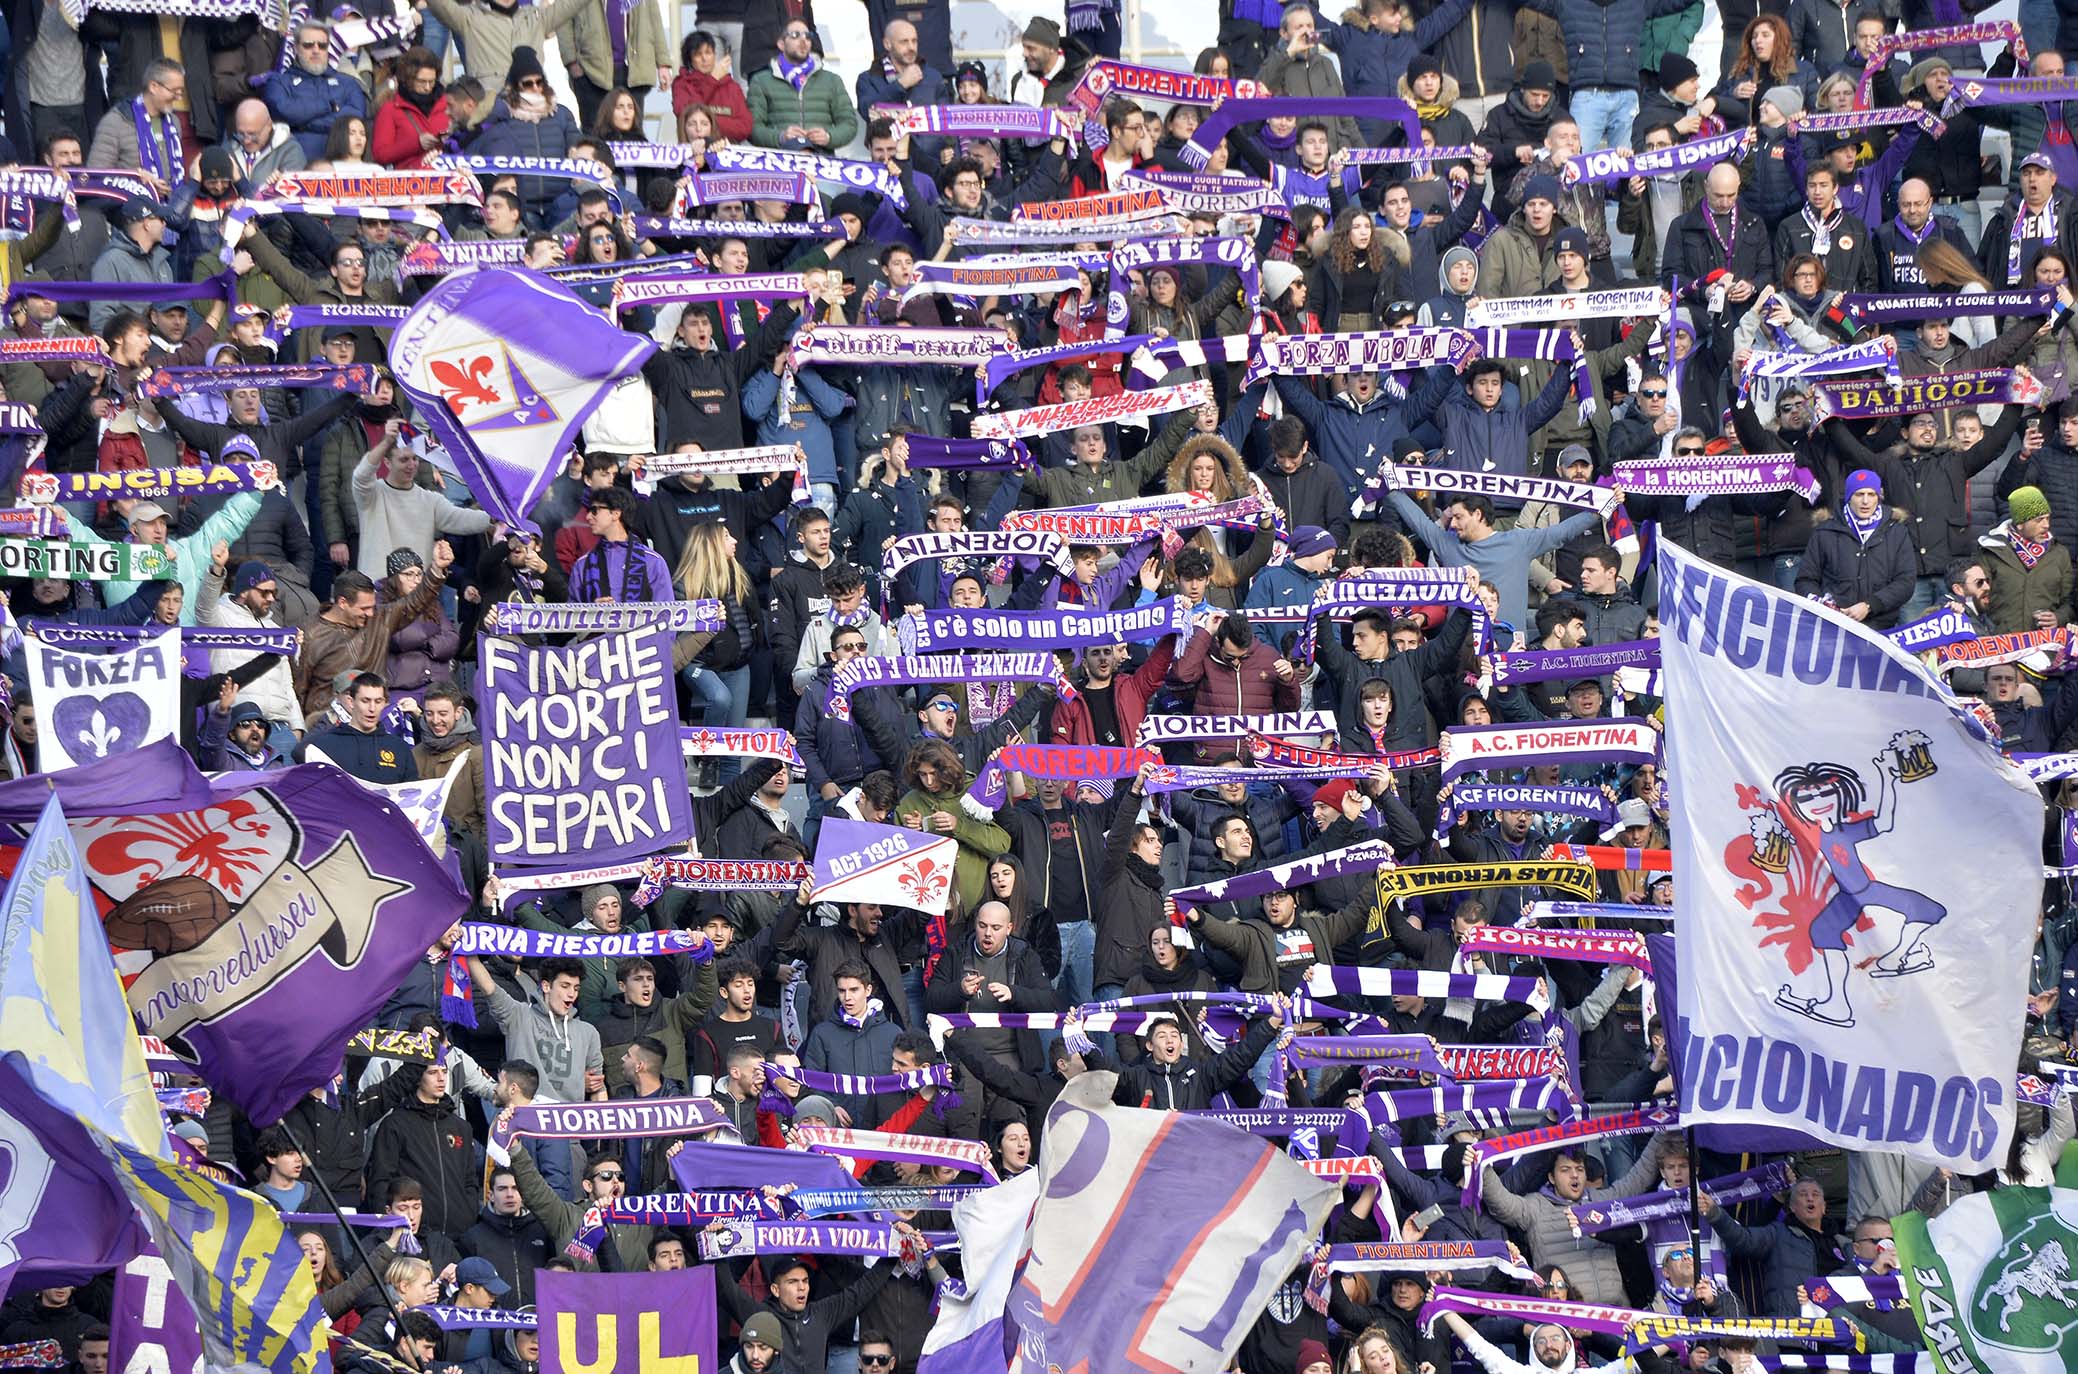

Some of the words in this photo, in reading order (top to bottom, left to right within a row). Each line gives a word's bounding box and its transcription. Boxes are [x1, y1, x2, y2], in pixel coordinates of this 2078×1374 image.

[1103, 66, 1233, 99] FIORENTINA
[952, 110, 1041, 127] FIORENTINA
[1635, 153, 1673, 169] PER
[1681, 137, 1738, 165] VINCI
[1588, 151, 1630, 177] NOI
[300, 176, 444, 198] FIORENTINA
[706, 178, 797, 197] FIORENTINA
[1023, 190, 1161, 220] FIORENTINA
[670, 219, 703, 232] ACF
[1111, 239, 1206, 271] GATE
[952, 267, 1059, 284] FIORENTINA
[631, 284, 692, 298] VIOLA
[1586, 291, 1654, 306] FIORENTINA
[1956, 295, 1995, 306] CUORE
[1997, 294, 2033, 305] VIOLA
[1278, 338, 1349, 367] FORZA
[72, 466, 243, 491] INCISA
[1405, 470, 1595, 506] FIORENTINA
[1645, 472, 1660, 486] la
[1667, 468, 1762, 486] FIORENTINA
[139, 487, 170, 497] 1966
[0, 546, 120, 574] ORTING
[934, 613, 964, 638] c'è
[977, 616, 1017, 639] solo
[1020, 618, 1056, 637] un
[1061, 606, 1165, 637] Capitano
[41, 645, 168, 688] FORZA
[888, 655, 899, 676] E
[907, 655, 965, 678] VANTO
[970, 652, 1049, 678] FIRENZE
[1541, 656, 1568, 670] A.C.
[1570, 650, 1647, 668] FIORENTINA
[496, 674, 670, 742] MORTE
[725, 732, 794, 760] VIOLA
[1472, 736, 1514, 754] A.C.
[1520, 729, 1639, 751] FIORENTINA
[491, 736, 582, 790] NON
[593, 730, 648, 783] CI
[1452, 787, 1489, 809] ACF
[1490, 789, 1603, 813] FIORENTINA
[489, 776, 672, 855] SEPARI
[830, 853, 862, 879] ACF
[863, 832, 911, 861] 1926
[663, 860, 809, 883] FIORENTINA
[1410, 869, 1513, 894] VERONA
[536, 1104, 705, 1132] FIORENTINA
[1488, 1111, 1641, 1154] FIORENTINA
[756, 1226, 823, 1248] FORZA
[827, 1227, 888, 1250] VIOLA
[1354, 1242, 1476, 1260] FIORENTINA
